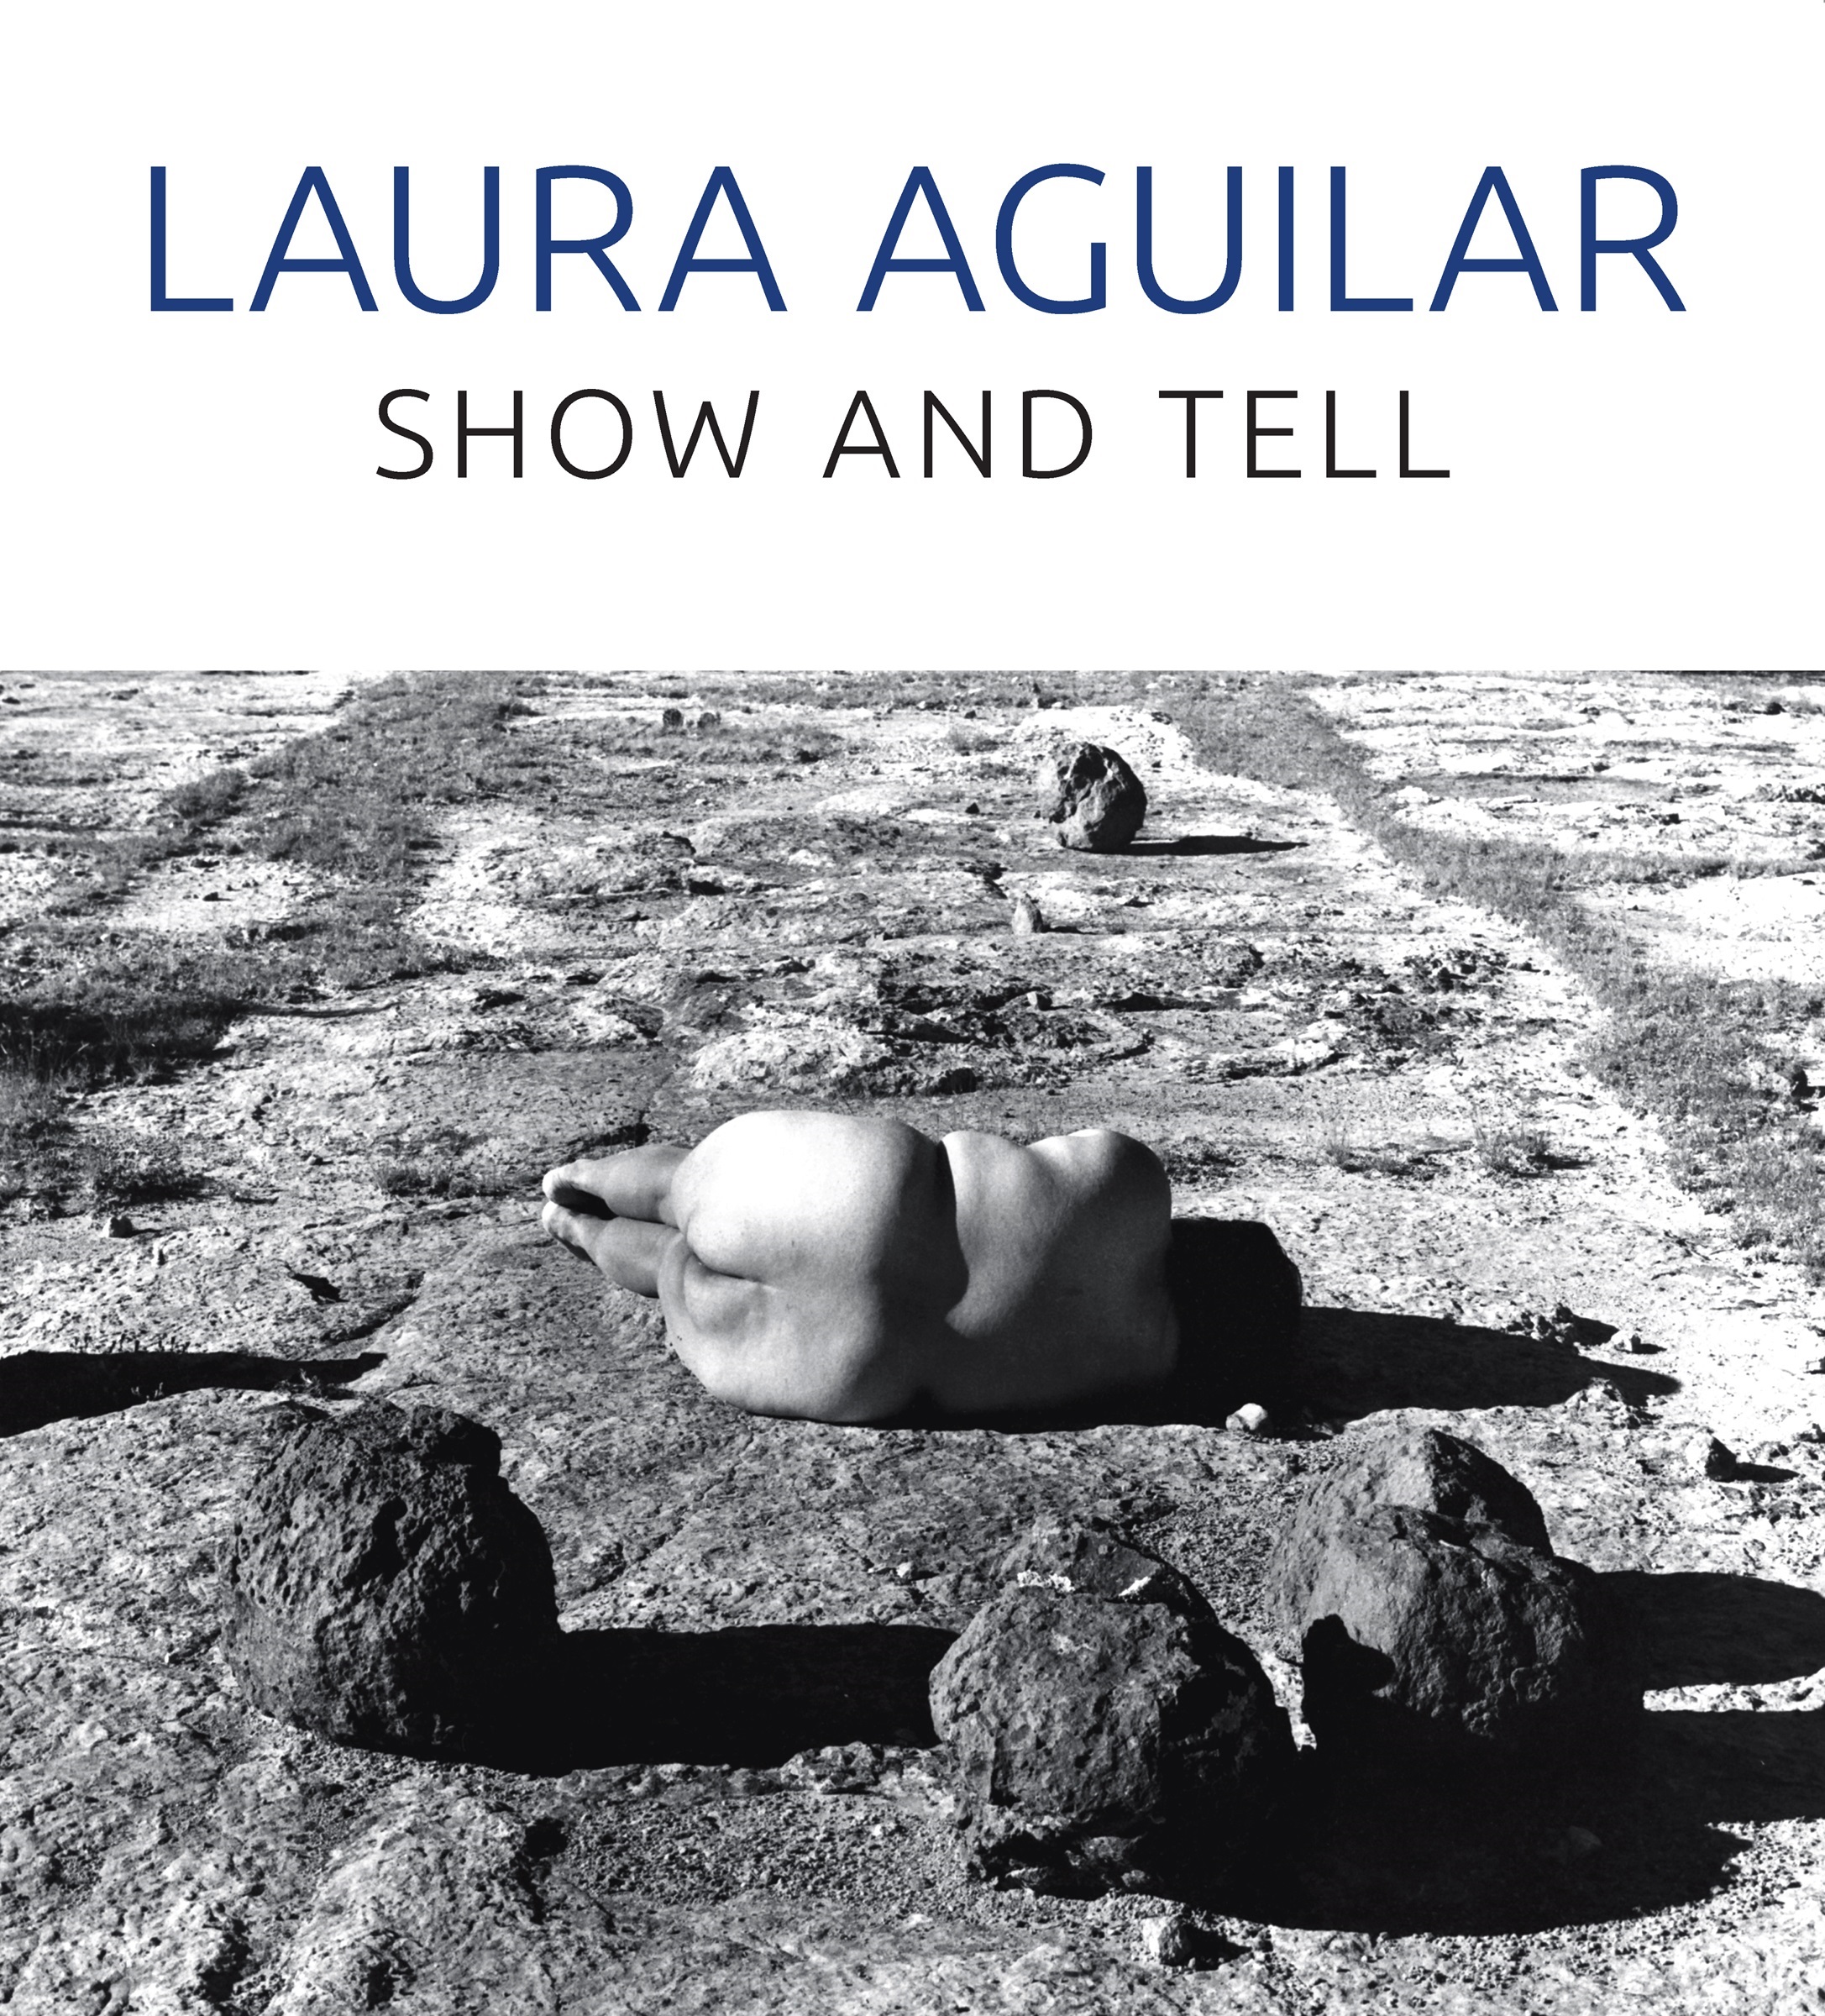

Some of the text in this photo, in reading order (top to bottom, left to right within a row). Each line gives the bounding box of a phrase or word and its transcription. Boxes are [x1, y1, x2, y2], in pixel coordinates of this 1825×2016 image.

[150, 163, 1687, 315] LAURA AGUILAR
[375, 388, 1450, 480] SHOW AND TELL
